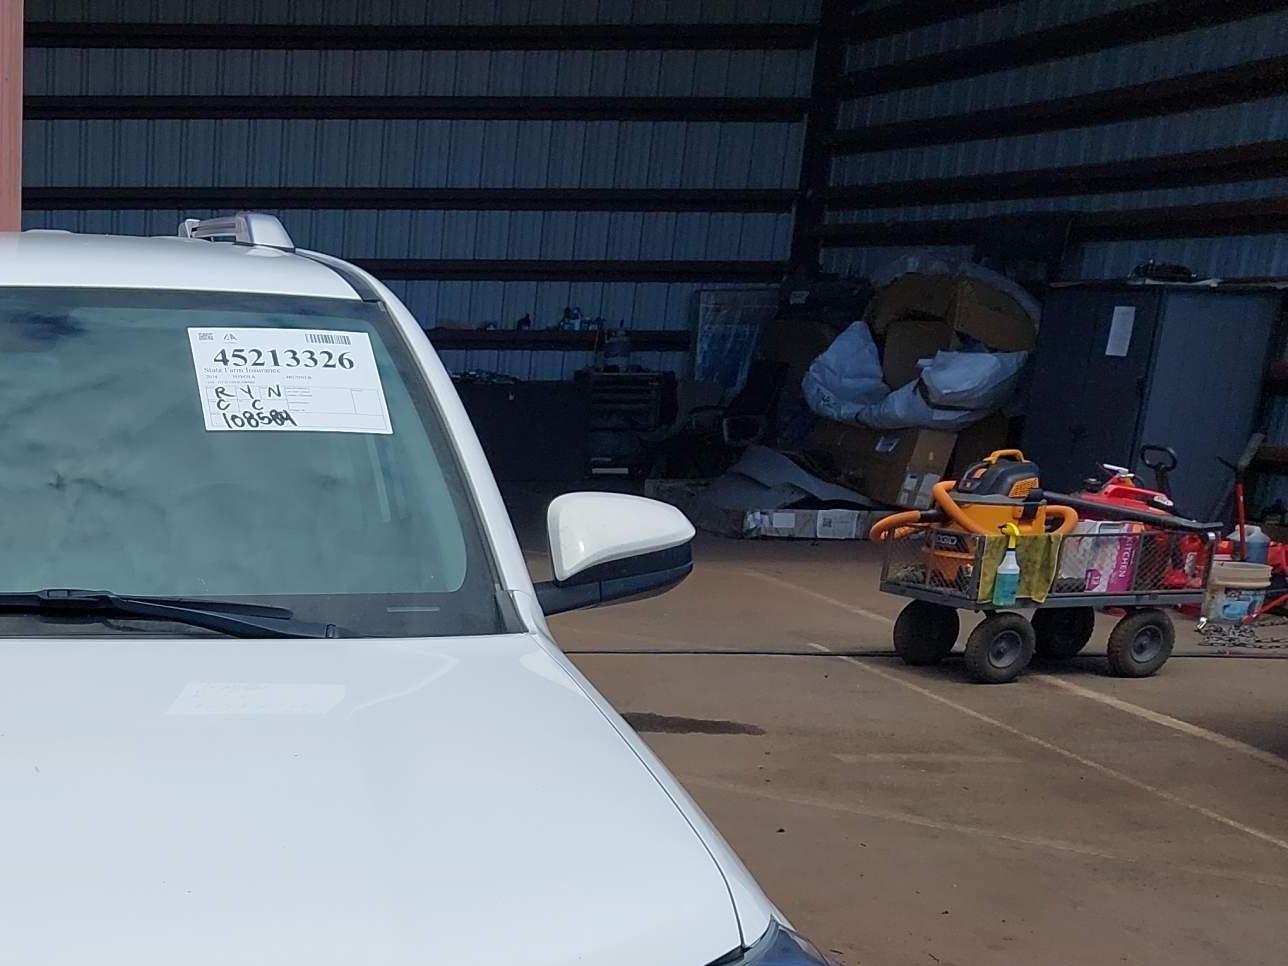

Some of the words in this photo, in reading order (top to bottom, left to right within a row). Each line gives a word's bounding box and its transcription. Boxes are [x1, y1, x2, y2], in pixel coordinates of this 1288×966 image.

[213, 348, 355, 369] 45213326
[215, 386, 236, 399] R
[239, 384, 255, 400] Y
[267, 384, 282, 398] N
